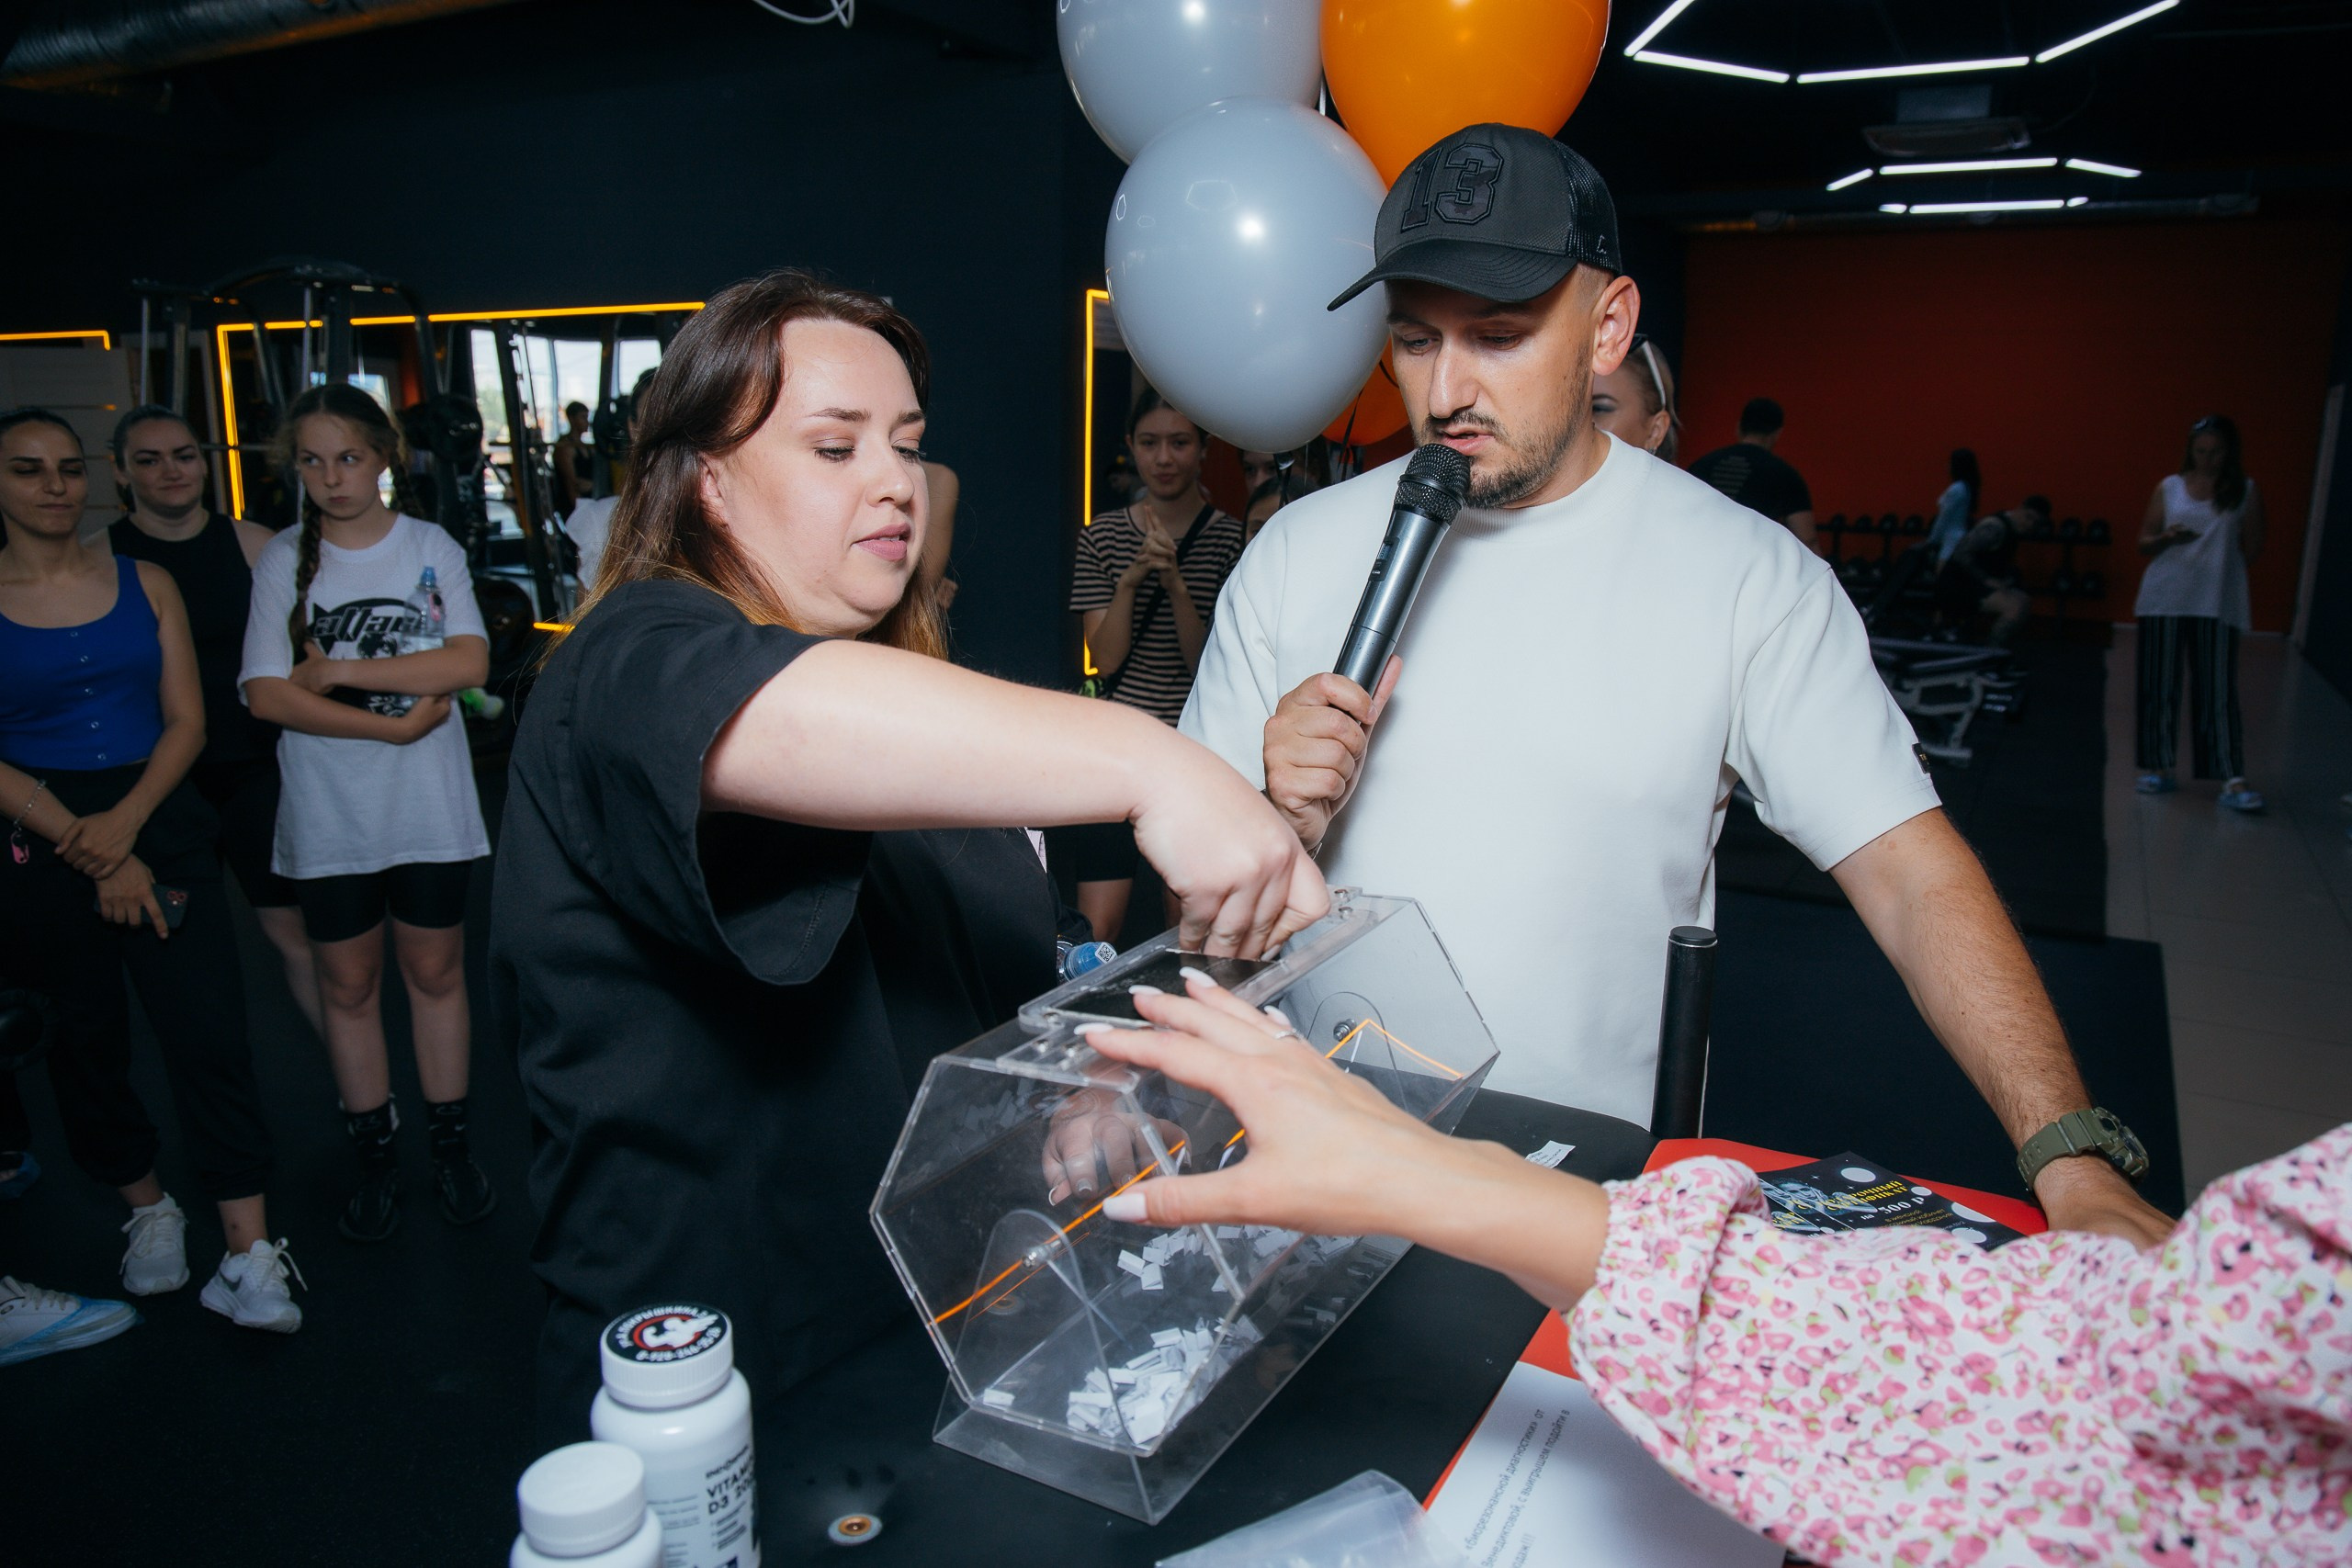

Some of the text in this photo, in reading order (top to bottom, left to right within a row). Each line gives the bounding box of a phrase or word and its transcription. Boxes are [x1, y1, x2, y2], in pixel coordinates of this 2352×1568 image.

[1400, 141, 1504, 233] 13
[1534, 1408, 1545, 1419] от
[1544, 1414, 1567, 1449] подойти
[708, 1495, 729, 1516] D3
